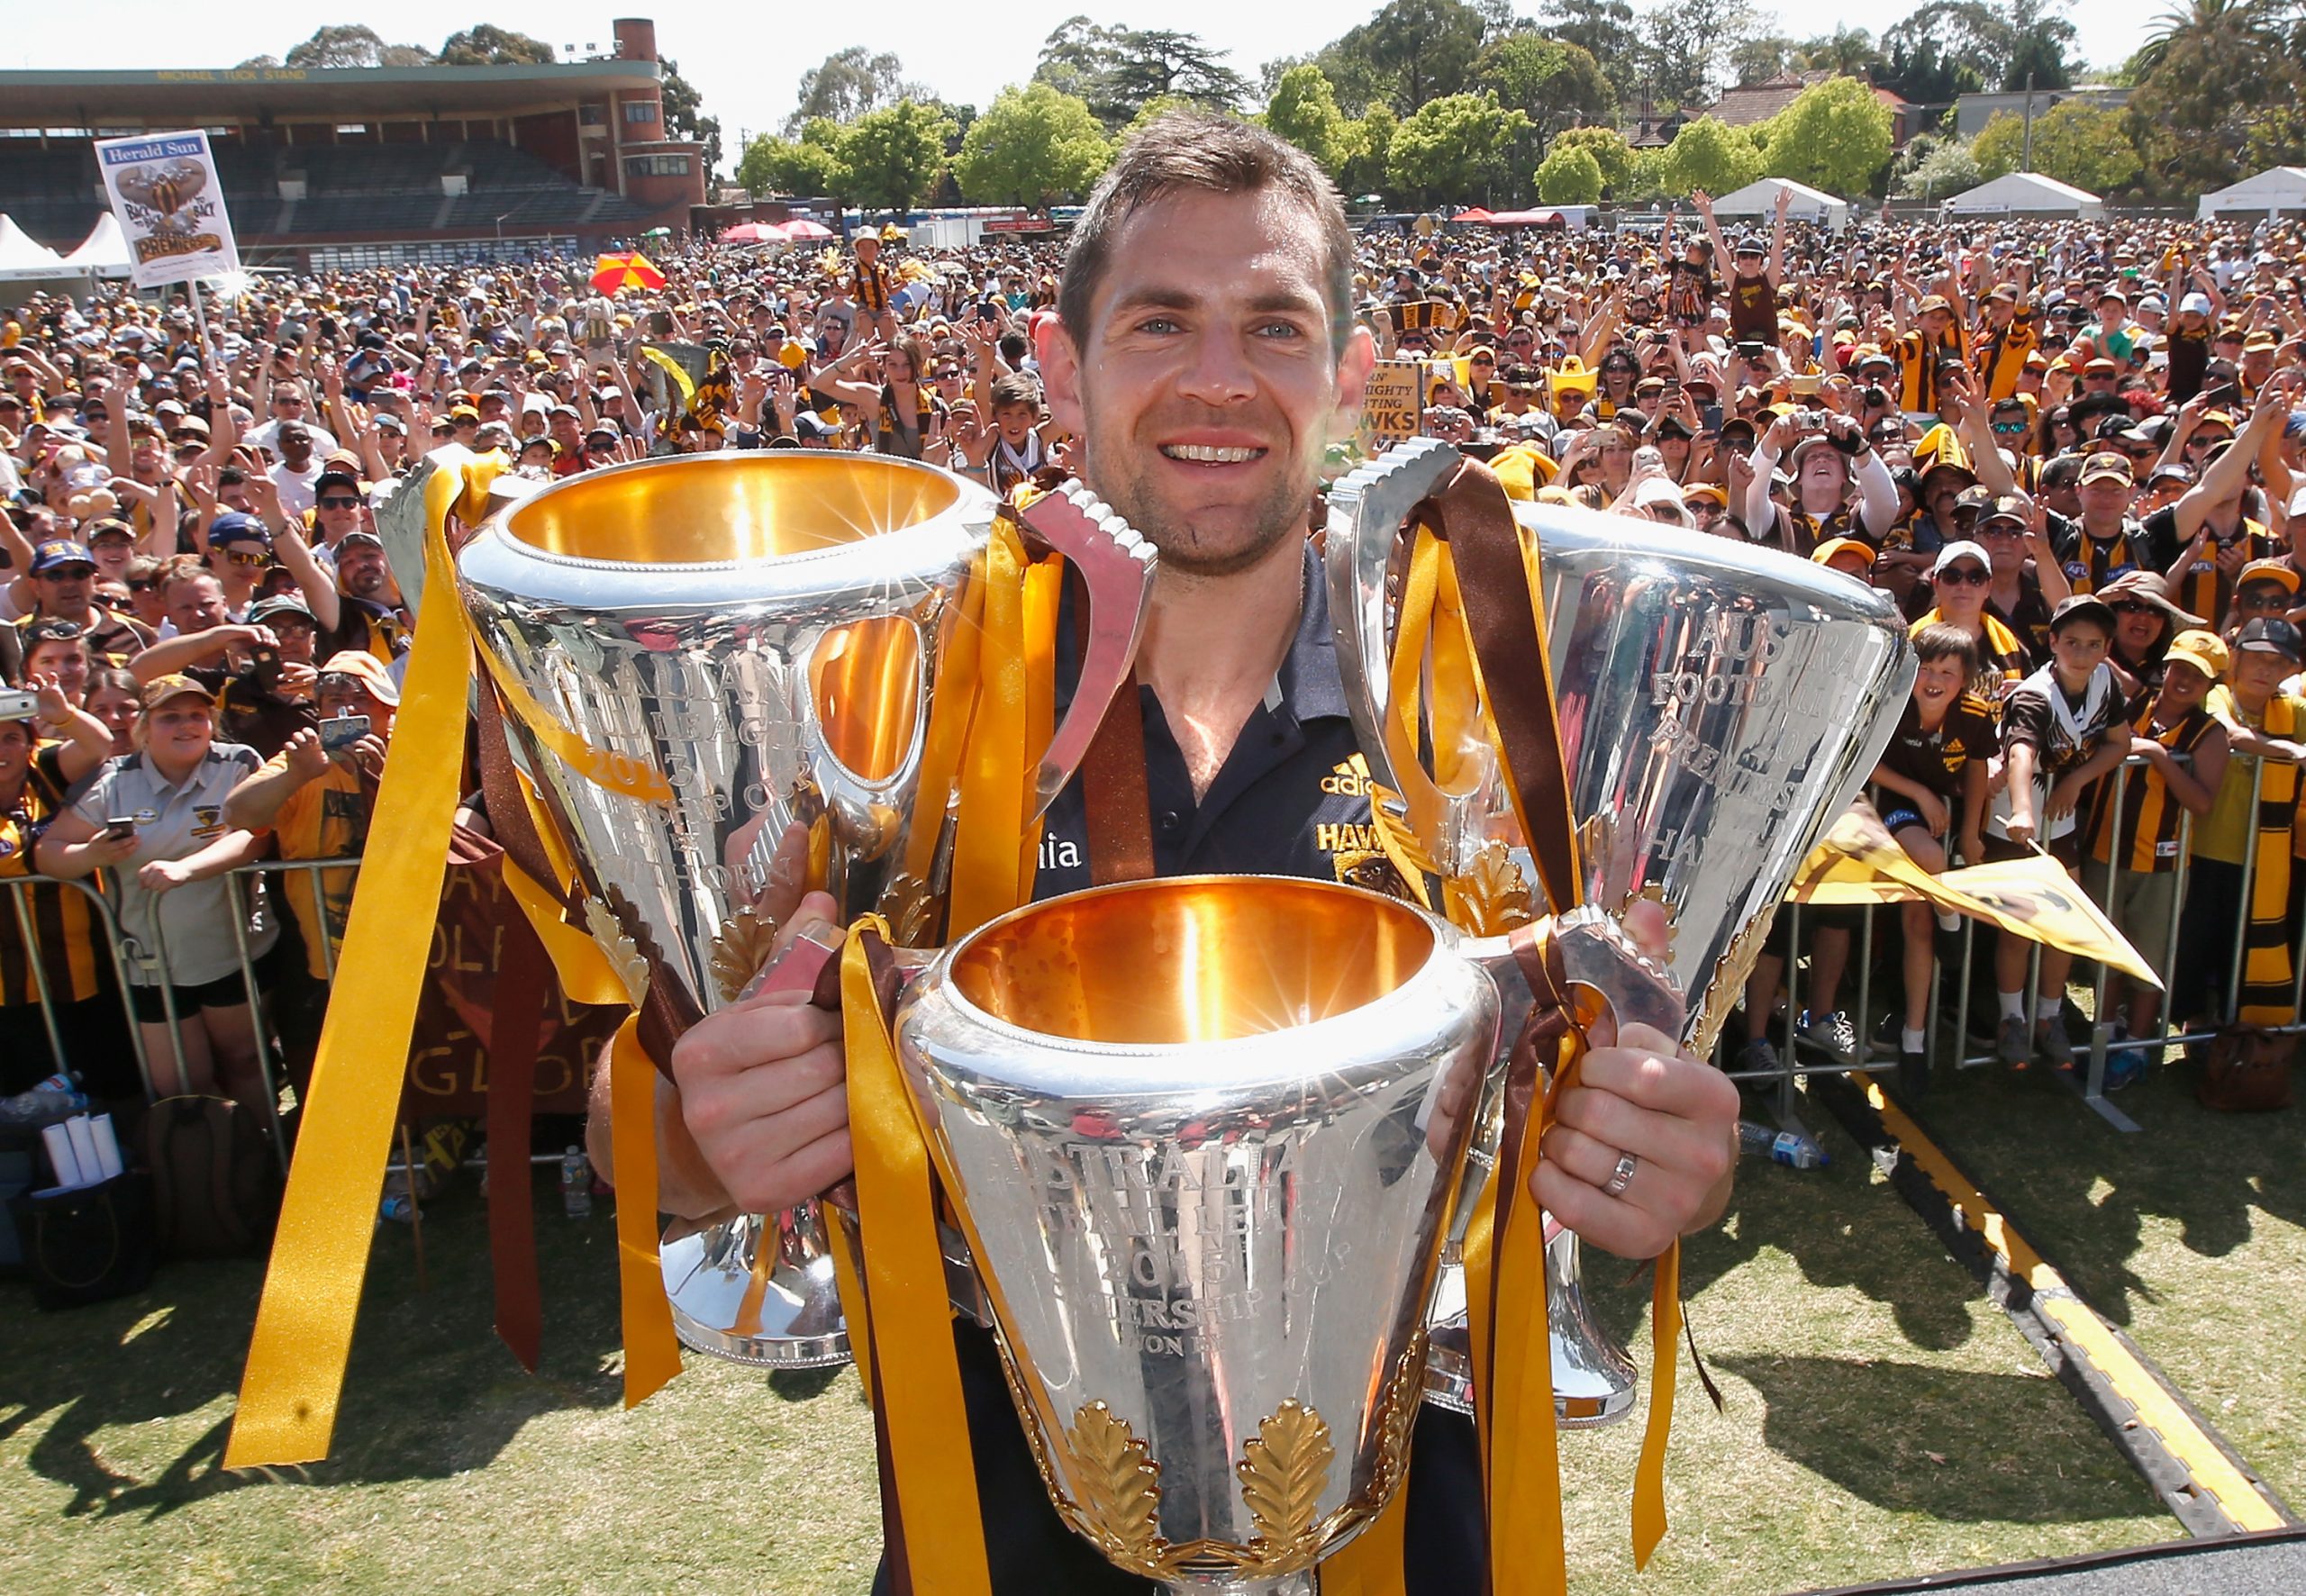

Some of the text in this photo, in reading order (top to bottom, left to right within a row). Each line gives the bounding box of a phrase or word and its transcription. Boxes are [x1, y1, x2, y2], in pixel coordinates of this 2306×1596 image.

[157, 69, 307, 80] MICHAEL TUCK STAND
[107, 141, 199, 163] Herald Sun
[124, 204, 150, 221] BACK
[193, 202, 215, 218] BACK
[145, 214, 162, 229] BACK
[139, 238, 204, 257] PREMIERS
[2066, 564, 2089, 577] AFL
[2189, 561, 2212, 571] AFL
[1652, 672, 1826, 718] FOOTBALL
[649, 711, 819, 753] LEAGUE
[587, 747, 695, 787] 2013
[995, 1128, 1351, 1192] STRALIAN
[1101, 1247, 1232, 1290] 2015
[1284, 1241, 1352, 1298] CUP
